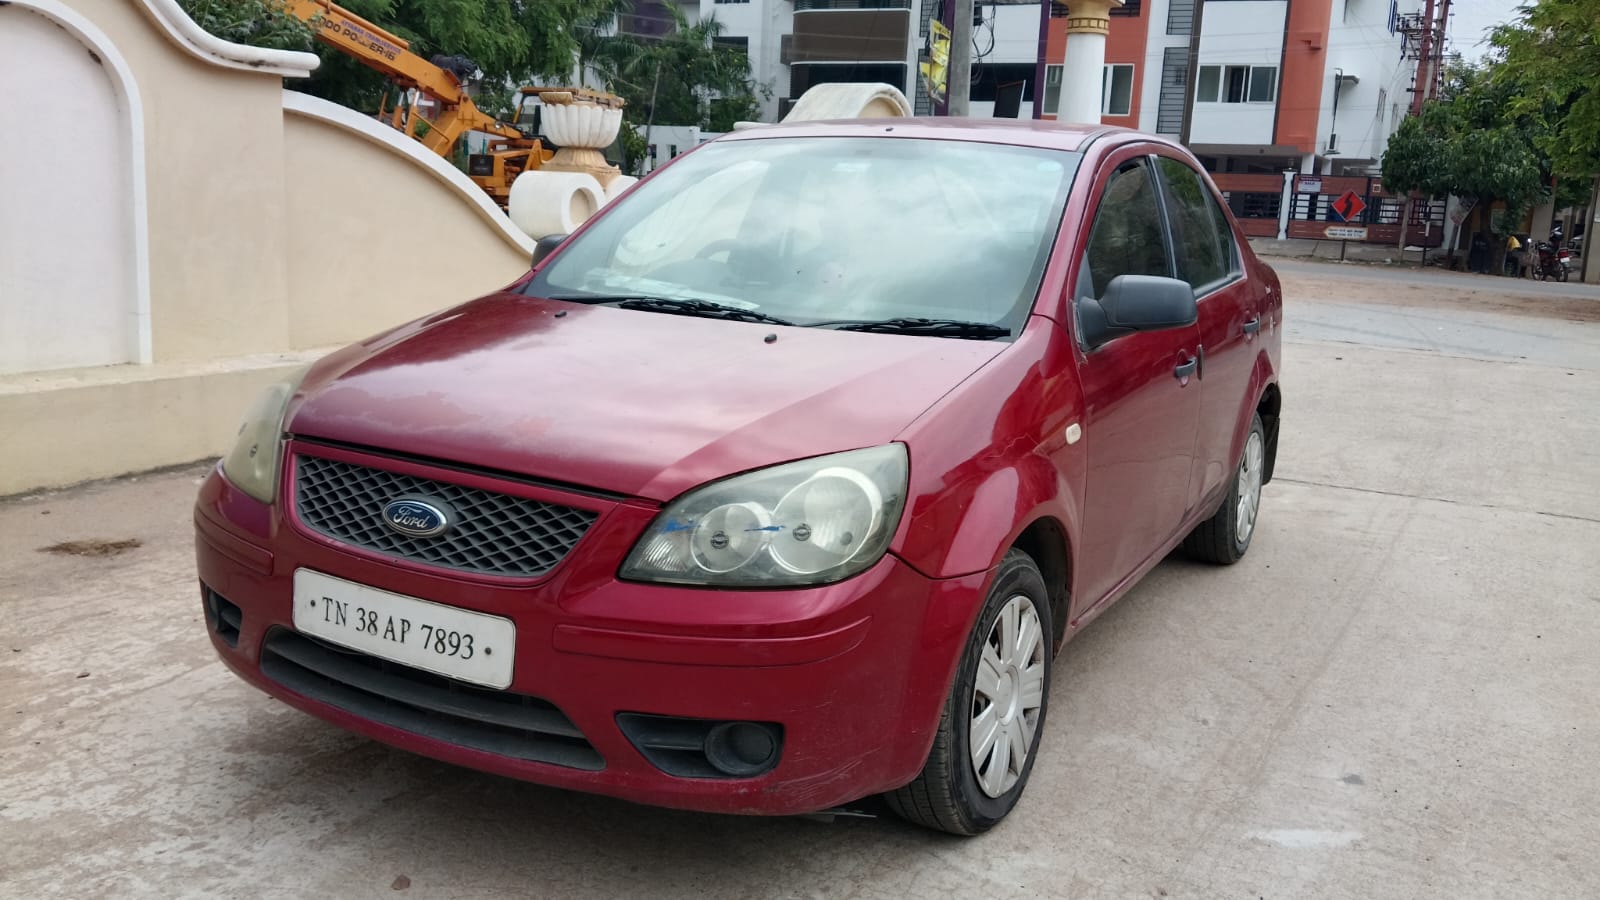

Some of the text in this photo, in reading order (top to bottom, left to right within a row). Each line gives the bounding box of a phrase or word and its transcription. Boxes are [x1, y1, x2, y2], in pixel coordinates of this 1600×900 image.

[393, 505, 430, 529] Ford
[322, 596, 475, 660] TN 38 AP 7893
